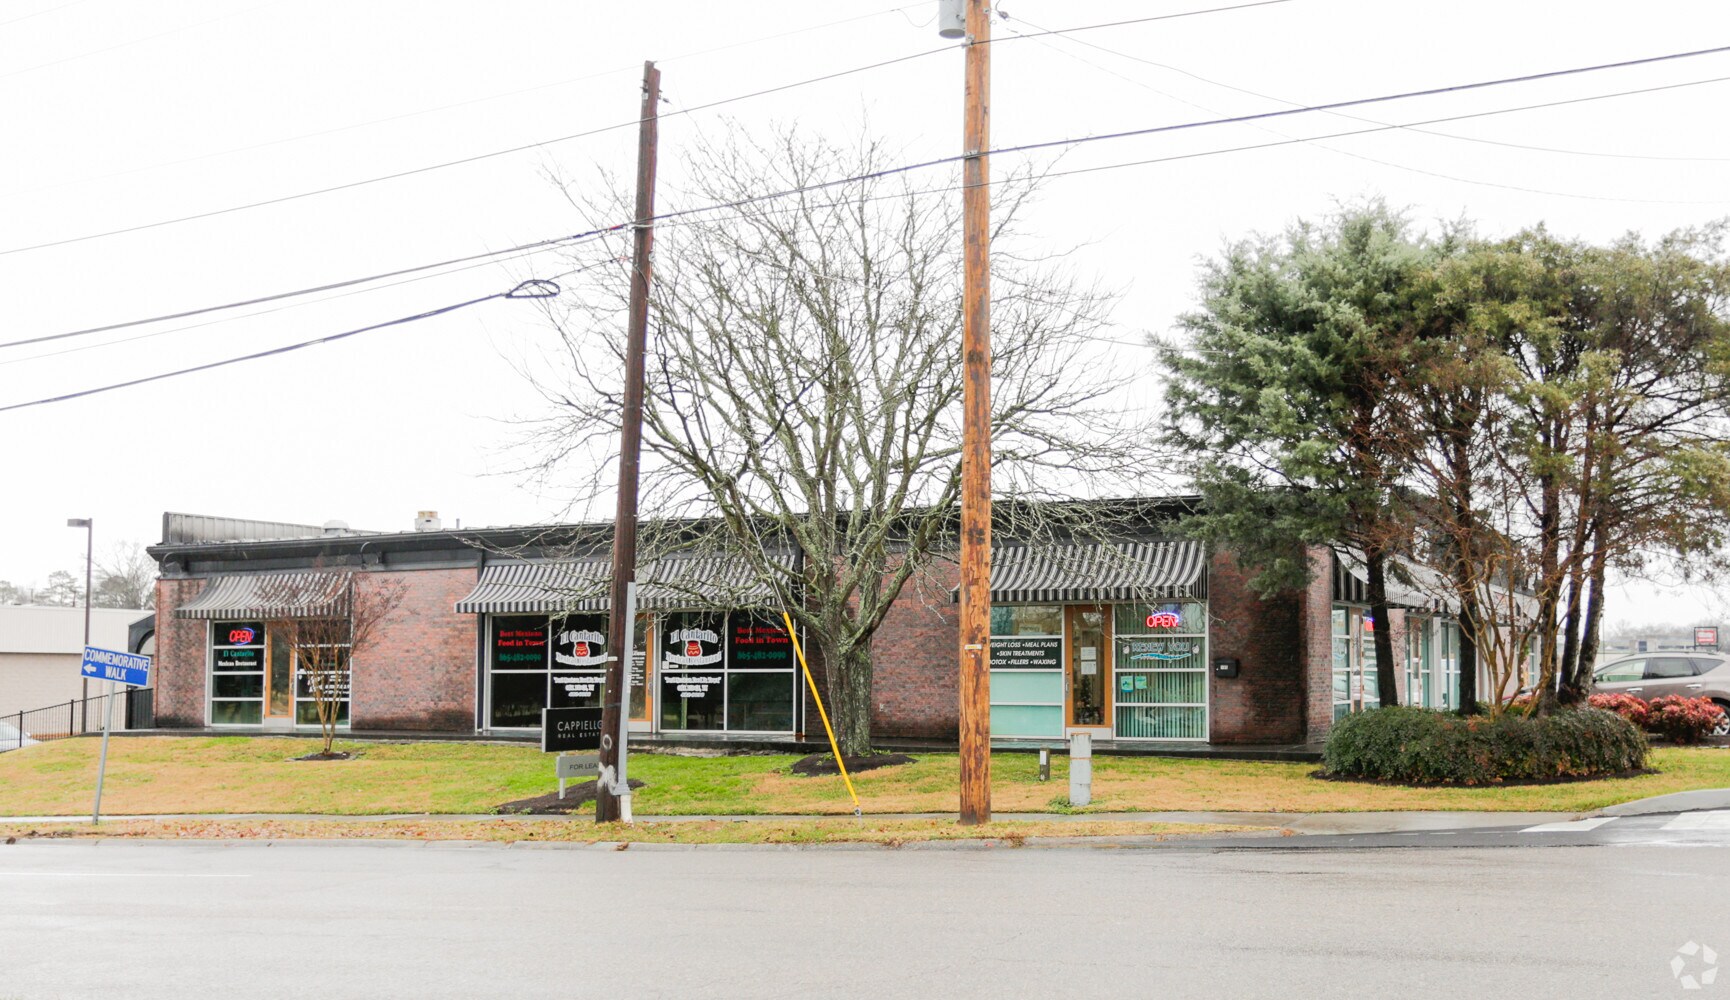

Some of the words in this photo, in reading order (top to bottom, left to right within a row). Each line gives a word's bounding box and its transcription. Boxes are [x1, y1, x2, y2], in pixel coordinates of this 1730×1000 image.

[1146, 615, 1178, 628] OPEN
[229, 630, 253, 643] OPEN
[560, 630, 569, 645] El
[570, 629, 605, 645] Cantarito
[670, 629, 680, 644] El
[680, 628, 718, 644] Cantarito
[735, 636, 754, 644] Food
[1132, 642, 1164, 652] RENEW
[1168, 642, 1189, 651] YOU
[84, 648, 149, 671] COMMEMORATIVE
[105, 665, 127, 680] WALK
